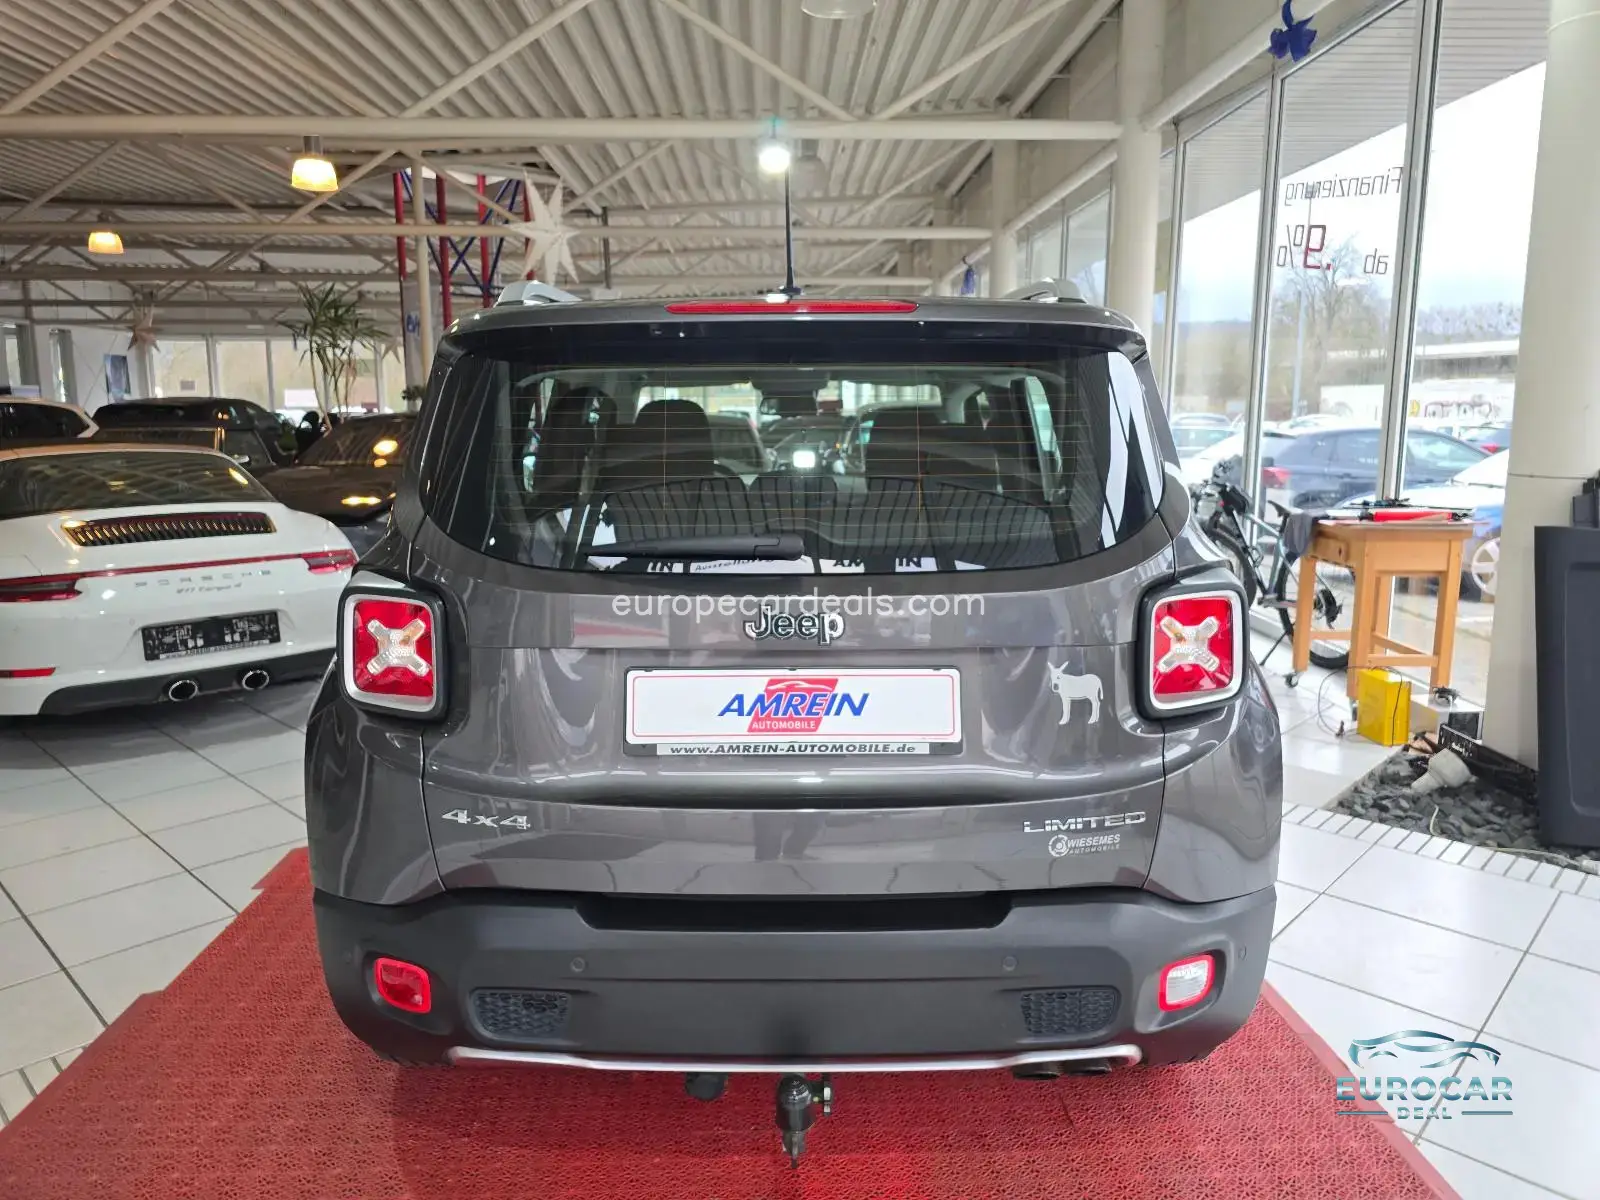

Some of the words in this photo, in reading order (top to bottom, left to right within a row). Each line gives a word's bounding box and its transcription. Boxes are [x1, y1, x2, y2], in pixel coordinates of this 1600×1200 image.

[744, 604, 845, 646] Jeep
[717, 692, 870, 717] AMREIN
[751, 720, 816, 730] AUTOMOBILE
[669, 742, 916, 754] www.AMREIN-AUTOMOBILE.de
[1023, 811, 1146, 833] LIMITED
[1067, 834, 1121, 848] WIESEMES
[1069, 843, 1120, 854] AUTOMOBILE
